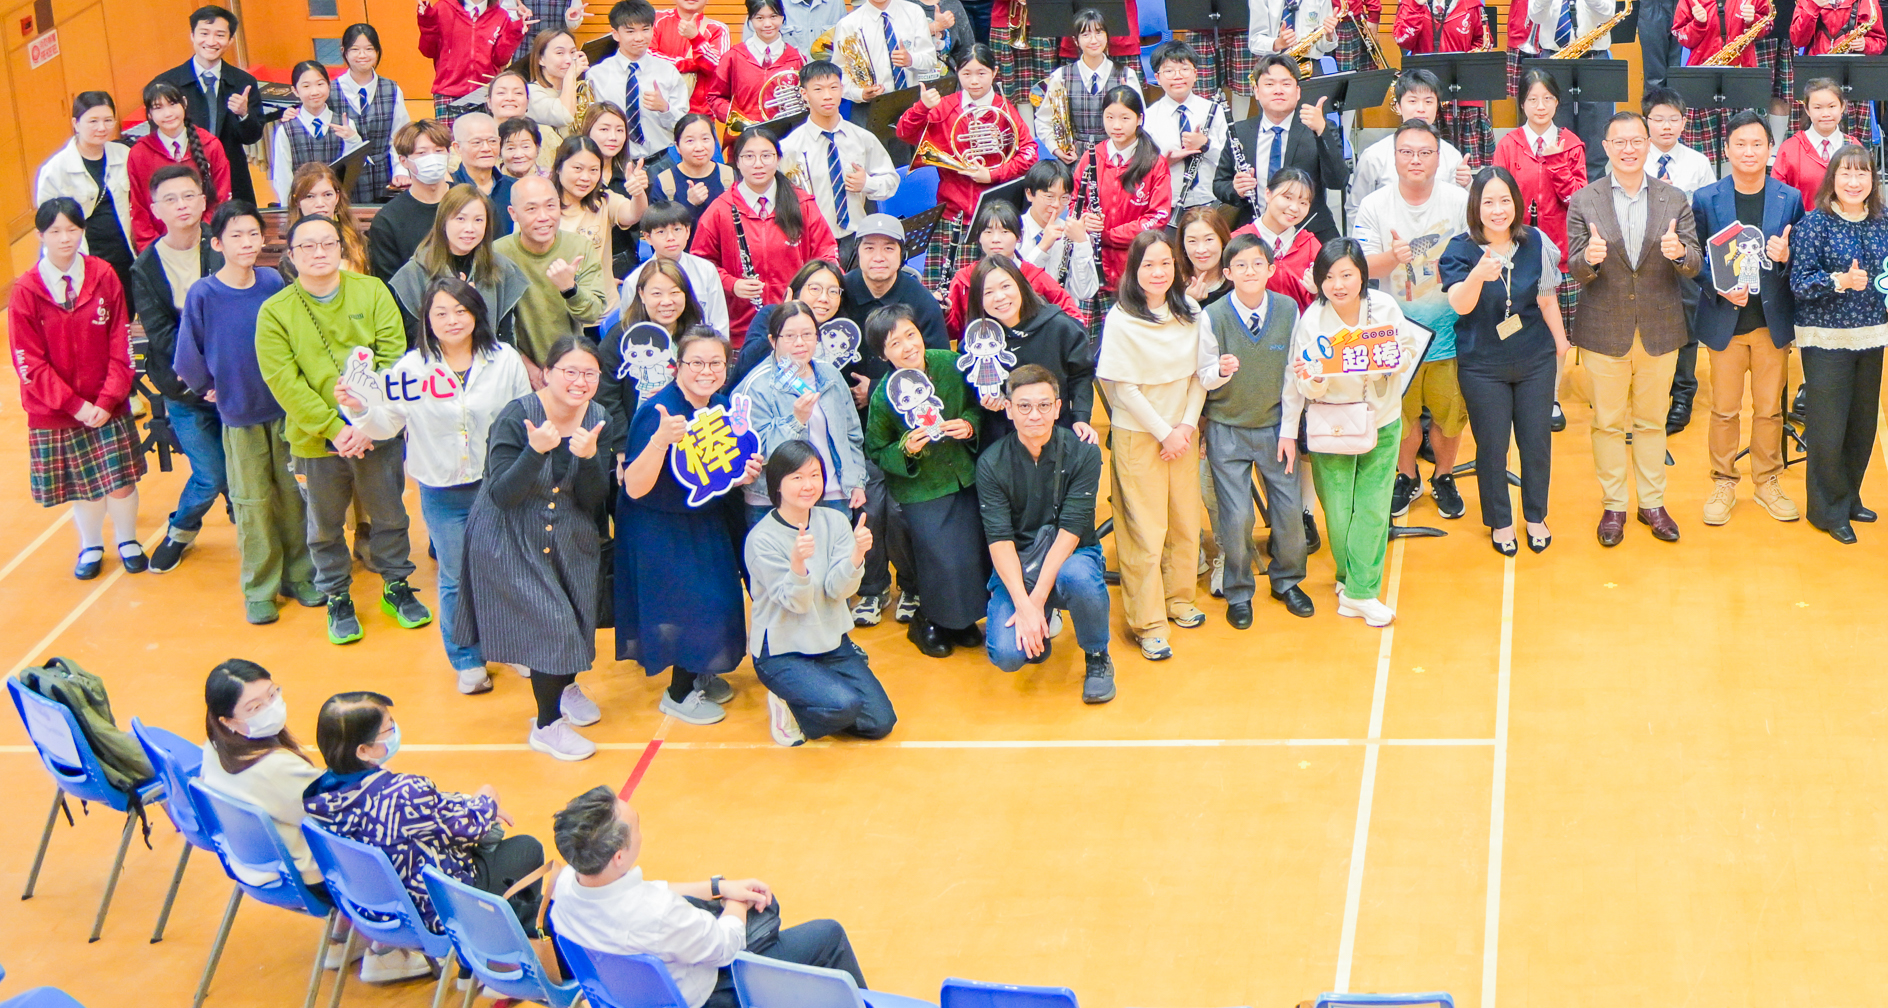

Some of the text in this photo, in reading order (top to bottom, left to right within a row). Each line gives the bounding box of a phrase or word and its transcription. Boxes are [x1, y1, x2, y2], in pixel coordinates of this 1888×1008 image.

[1361, 328, 1399, 340] GOOD!
[1342, 340, 1401, 373] 超棒
[385, 367, 457, 402] 比心
[677, 408, 742, 487] 棒
